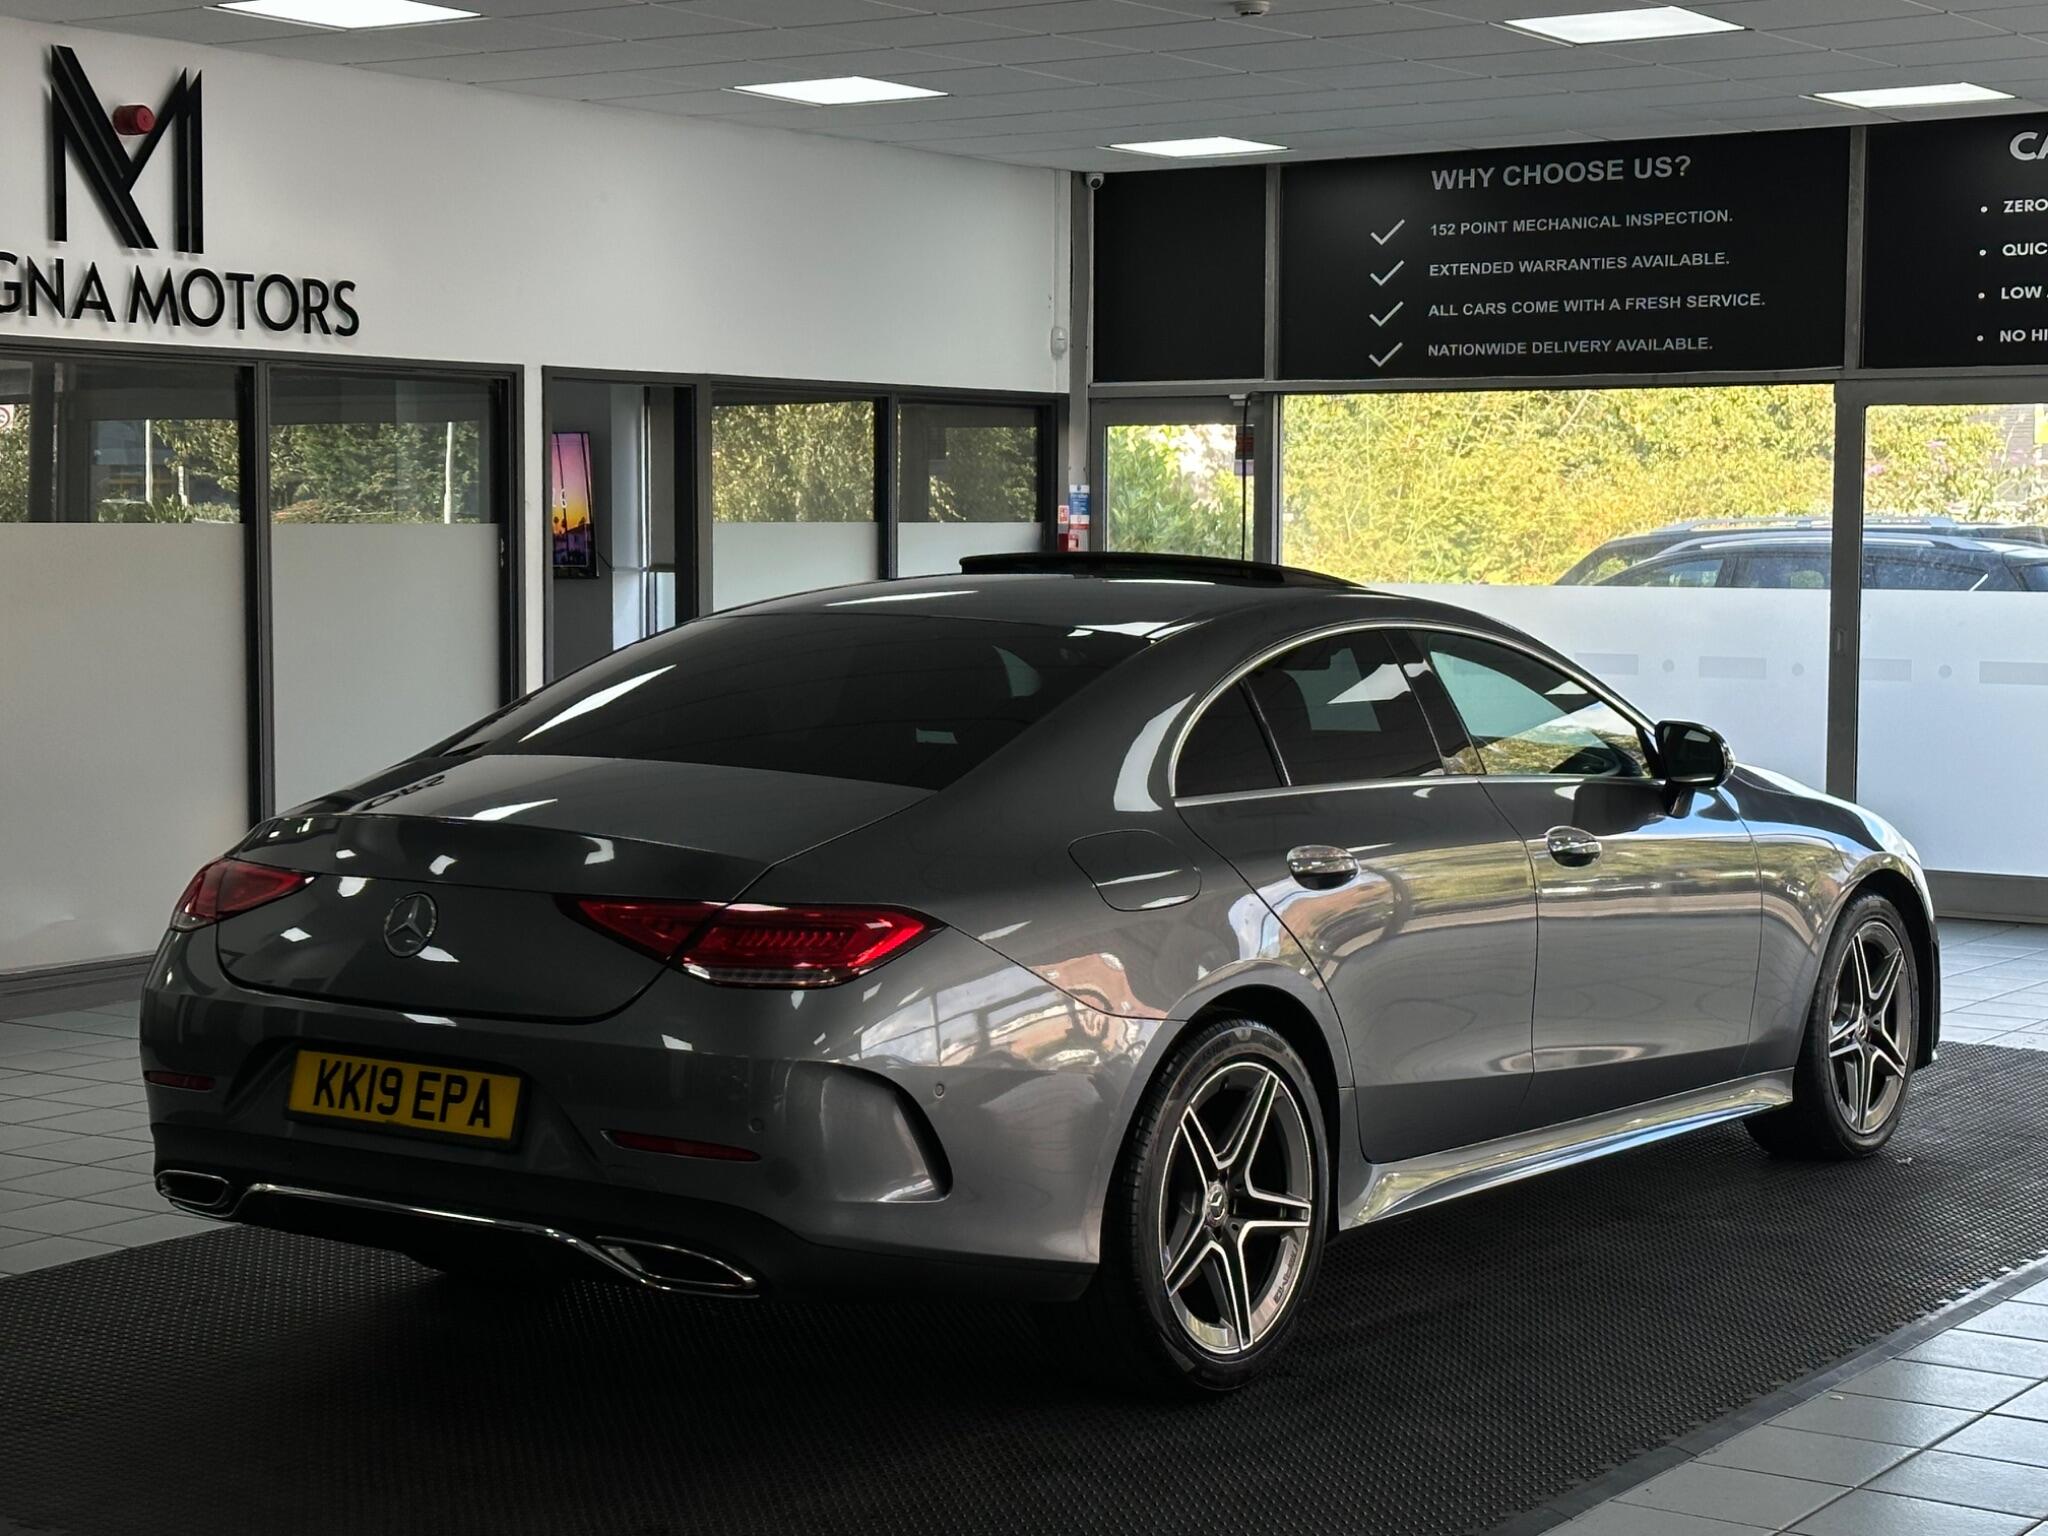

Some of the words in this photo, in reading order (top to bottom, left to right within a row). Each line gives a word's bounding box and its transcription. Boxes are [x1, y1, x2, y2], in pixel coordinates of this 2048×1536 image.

[1431, 167, 1496, 191] WHY
[1502, 159, 1625, 187] CHOOSE
[1633, 155, 1692, 179] US?
[1430, 223, 1456, 237] 152
[1460, 220, 1508, 235] POINT
[1512, 215, 1622, 233] MECHANICAL
[1626, 209, 1733, 227] INSPECTION.
[1429, 261, 1514, 277] EXTENDED
[1518, 256, 1628, 273] WARRANTIES
[1631, 251, 1730, 268] AVAILABLE.
[128, 265, 361, 338] MOTORS
[1427, 303, 1459, 317] ALL
[1462, 302, 1507, 316] CARS
[1511, 300, 1559, 314] COME
[1563, 298, 1605, 312] WITH
[1608, 298, 1621, 311] A
[1625, 295, 1681, 311] FRESH
[1686, 292, 1766, 309] SERVICE.
[2001, 285, 2043, 300] LOW
[1428, 342, 1527, 357] NATIONWIDE
[1532, 339, 1612, 354] DELIVERY
[1615, 337, 1713, 352] AVAILABLE.
[2000, 329, 2027, 343] NO
[313, 1058, 404, 1117] KK19
[411, 1070, 492, 1129] EPA
